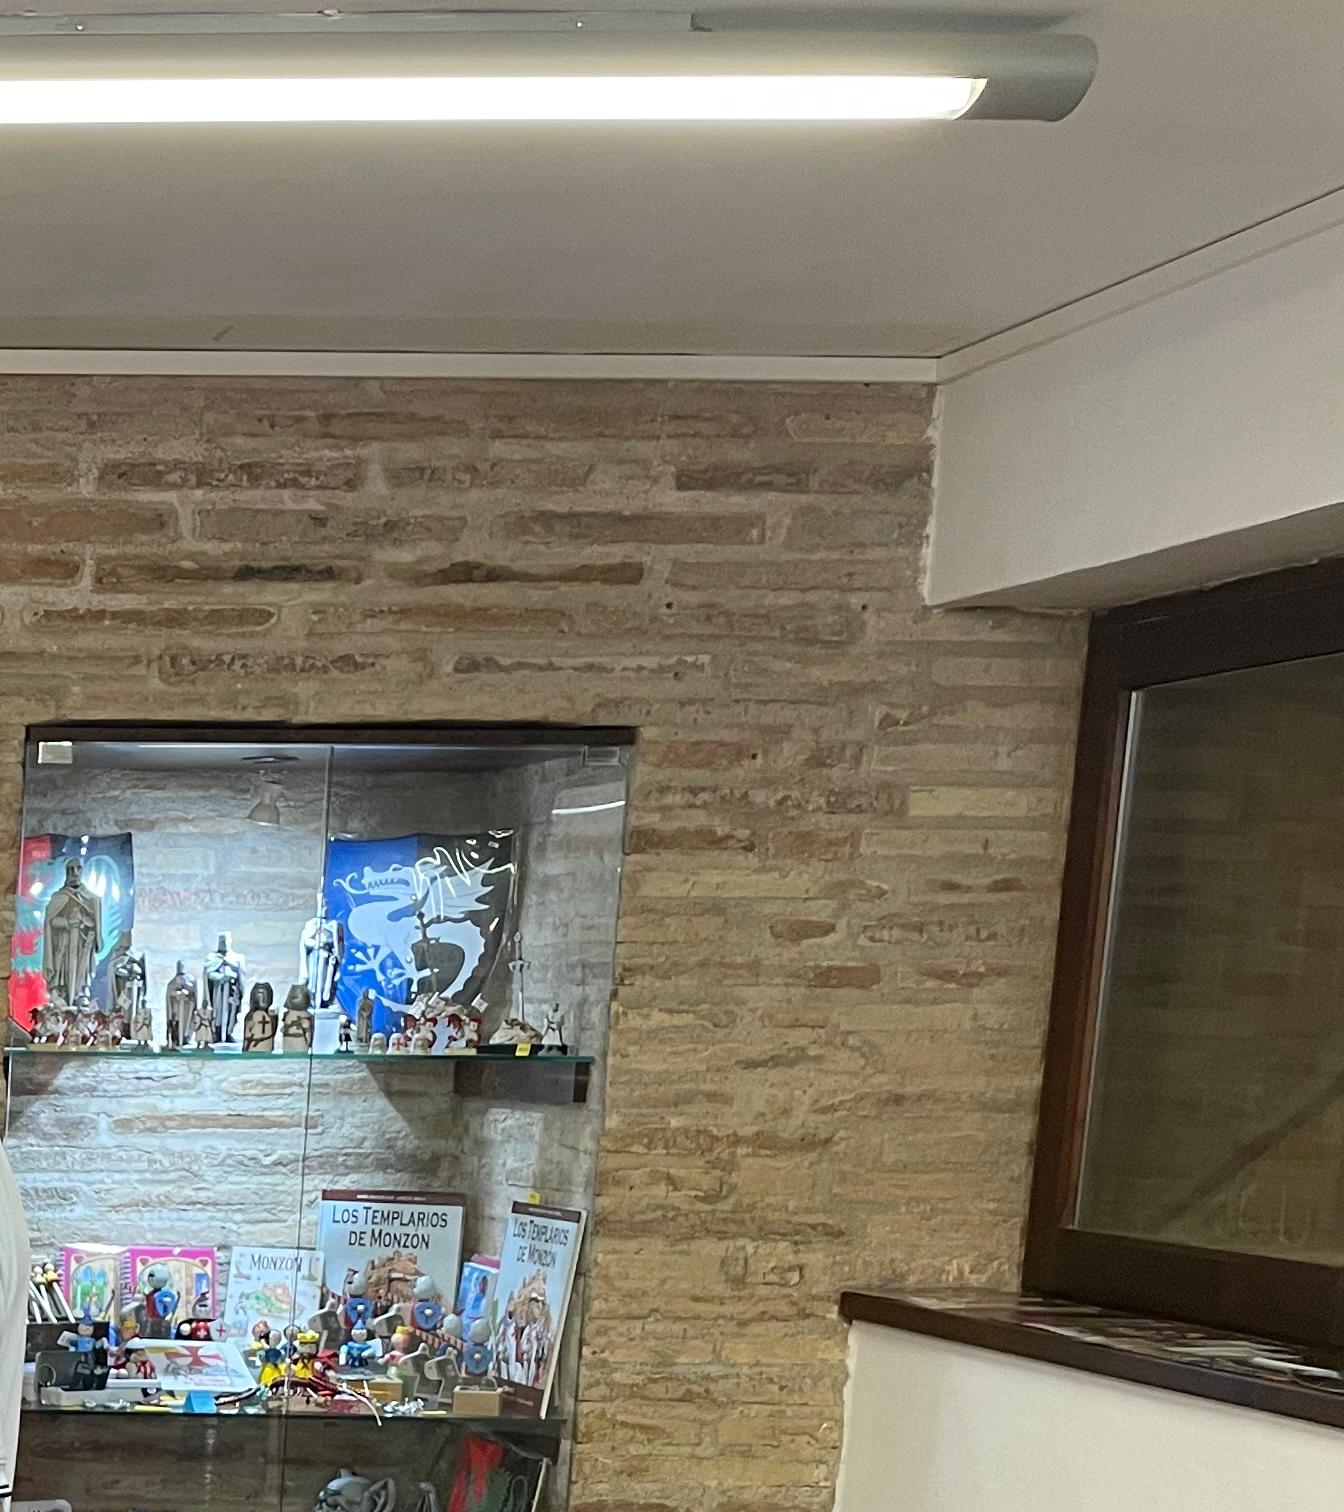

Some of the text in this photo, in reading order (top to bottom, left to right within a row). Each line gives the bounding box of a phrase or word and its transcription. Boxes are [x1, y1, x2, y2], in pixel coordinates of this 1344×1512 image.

[332, 1205, 449, 1229] LOS TEMPLARIOS
[348, 1230, 367, 1247] DE
